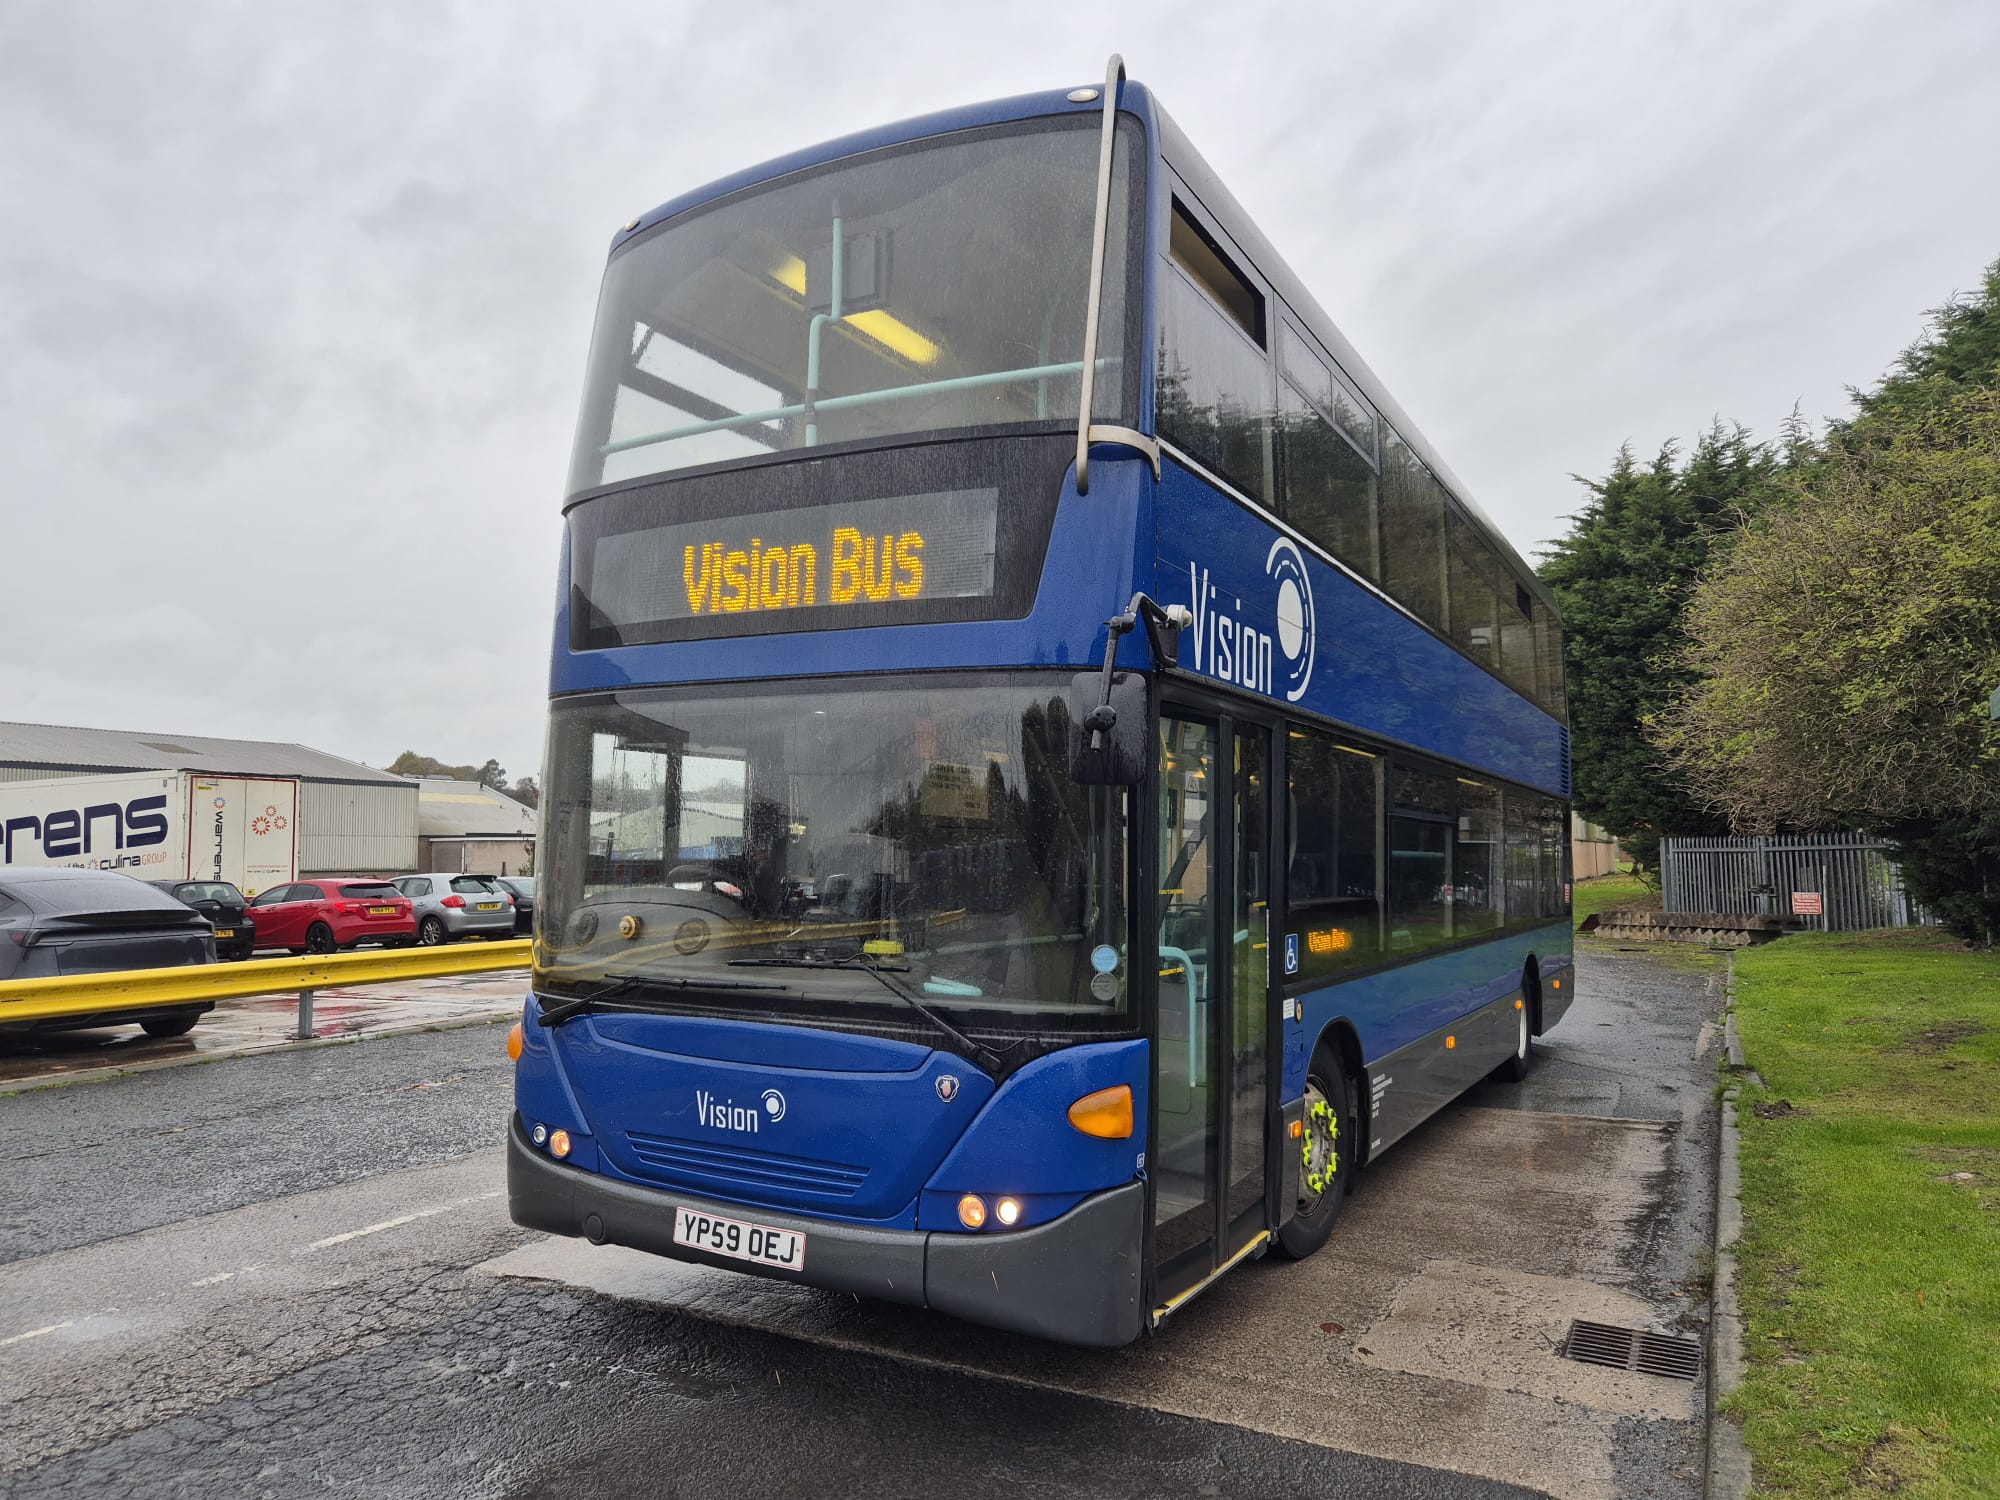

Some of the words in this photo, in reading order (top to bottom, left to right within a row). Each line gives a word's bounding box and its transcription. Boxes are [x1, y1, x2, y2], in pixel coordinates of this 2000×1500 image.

[683, 537, 817, 614] Vision
[830, 526, 925, 604] Bus
[1190, 561, 1272, 695] Vision
[0, 794, 169, 865] rens
[100, 854, 141, 871] culina
[142, 851, 168, 866] GROUP
[213, 810, 224, 881] warrens
[696, 1090, 759, 1133] Vision
[684, 1213, 741, 1252] YP59
[748, 1228, 796, 1263] OEJ
